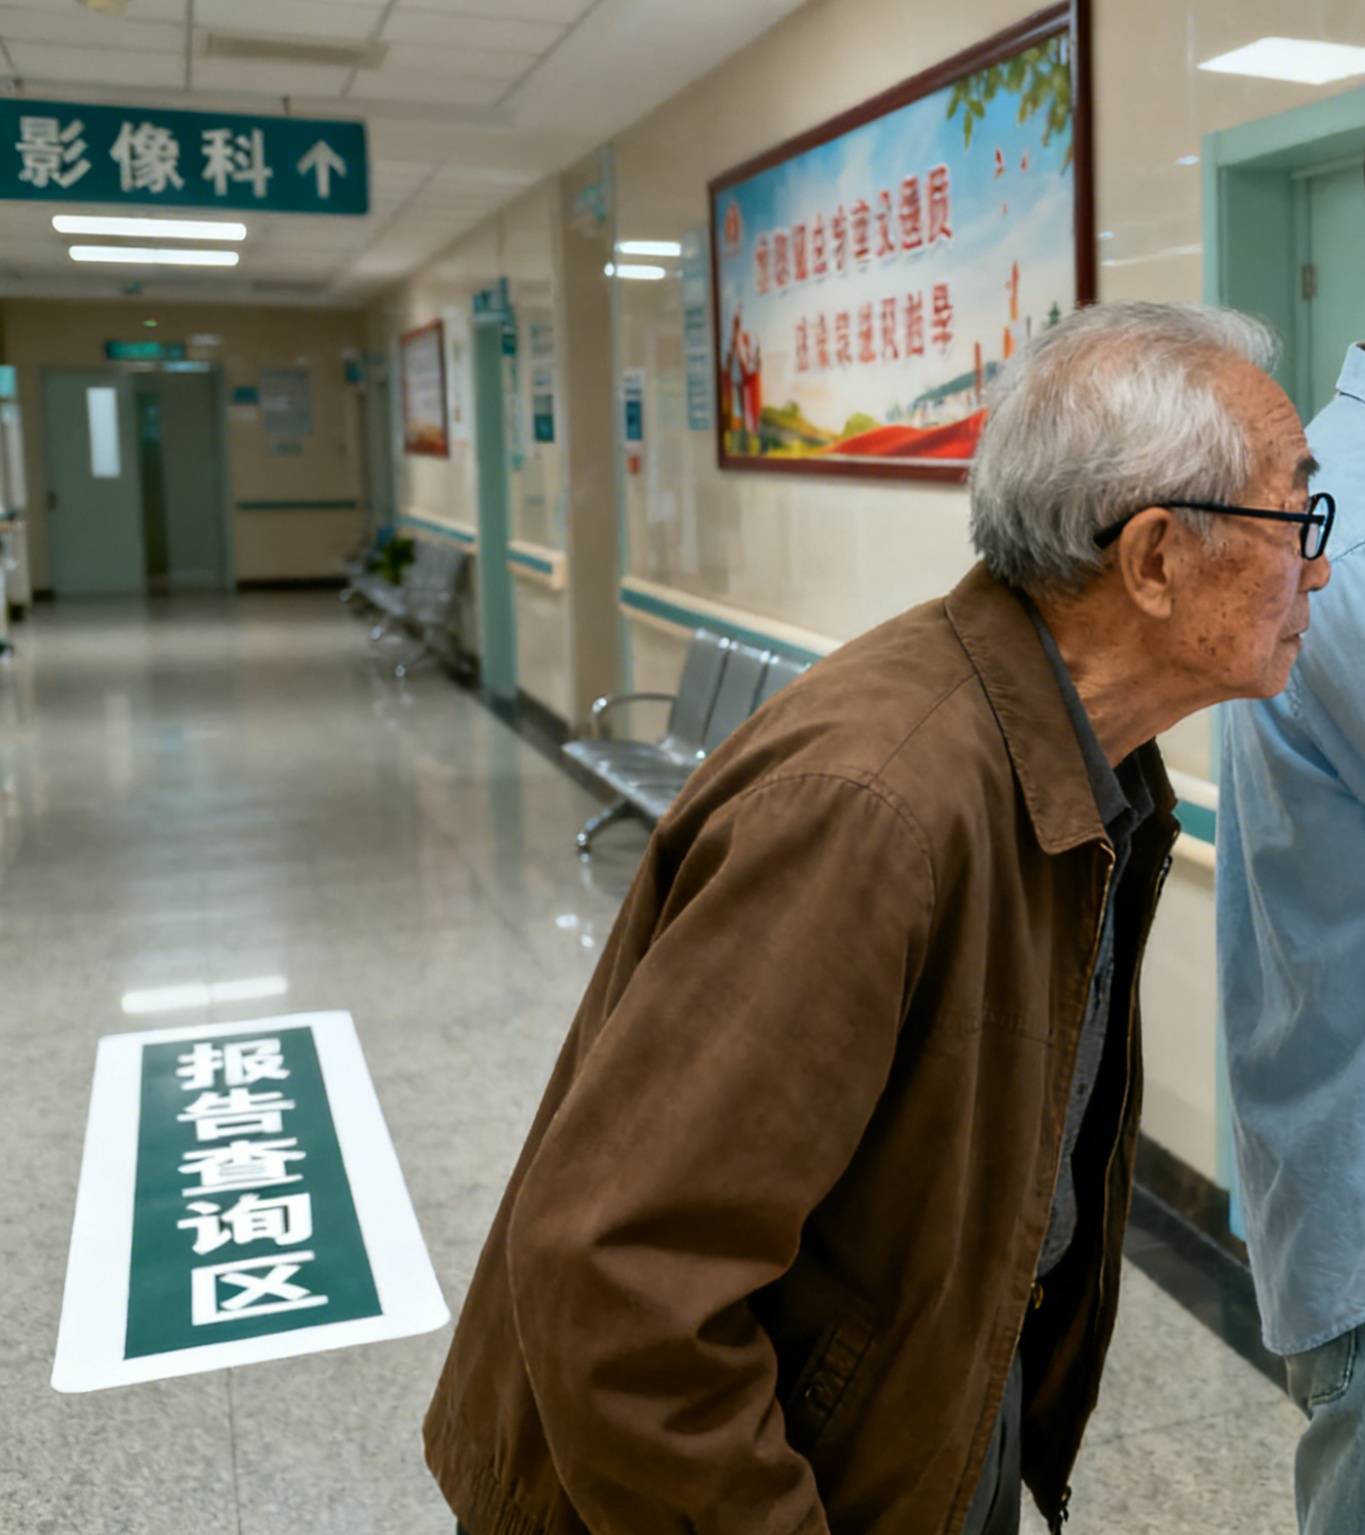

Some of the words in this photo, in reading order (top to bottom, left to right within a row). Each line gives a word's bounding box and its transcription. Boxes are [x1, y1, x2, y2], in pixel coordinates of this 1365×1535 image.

[15, 115, 273, 198] 影像科
[175, 1038, 329, 1327] 报告查询区
